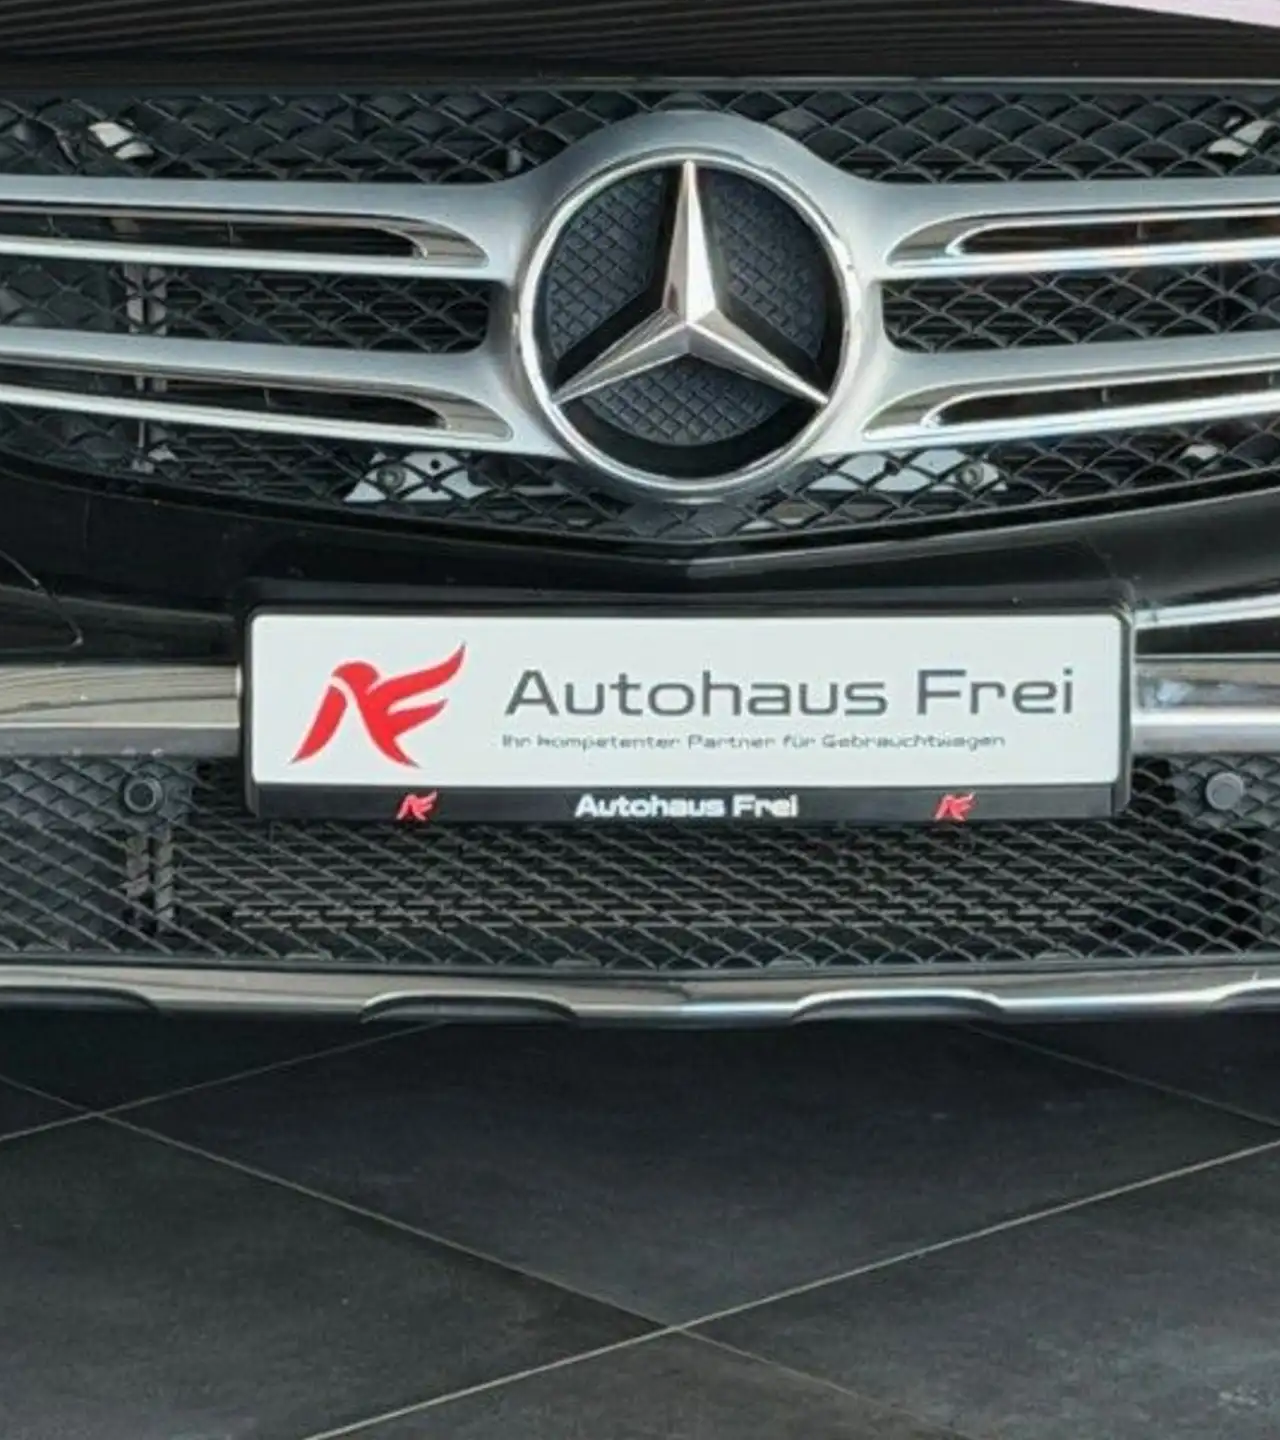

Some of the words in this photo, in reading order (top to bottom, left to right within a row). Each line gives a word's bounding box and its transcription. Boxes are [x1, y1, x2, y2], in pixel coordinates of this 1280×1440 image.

[505, 668, 888, 717] Autohaus
[916, 667, 1074, 716] Frei
[501, 734, 531, 748] Ihr
[537, 734, 680, 752] kompetenter
[687, 734, 775, 749] Partner
[782, 734, 816, 749] für
[822, 734, 1007, 752] Gebrauchtwagen
[574, 793, 726, 818] Autohaus
[732, 793, 799, 818] Frei
